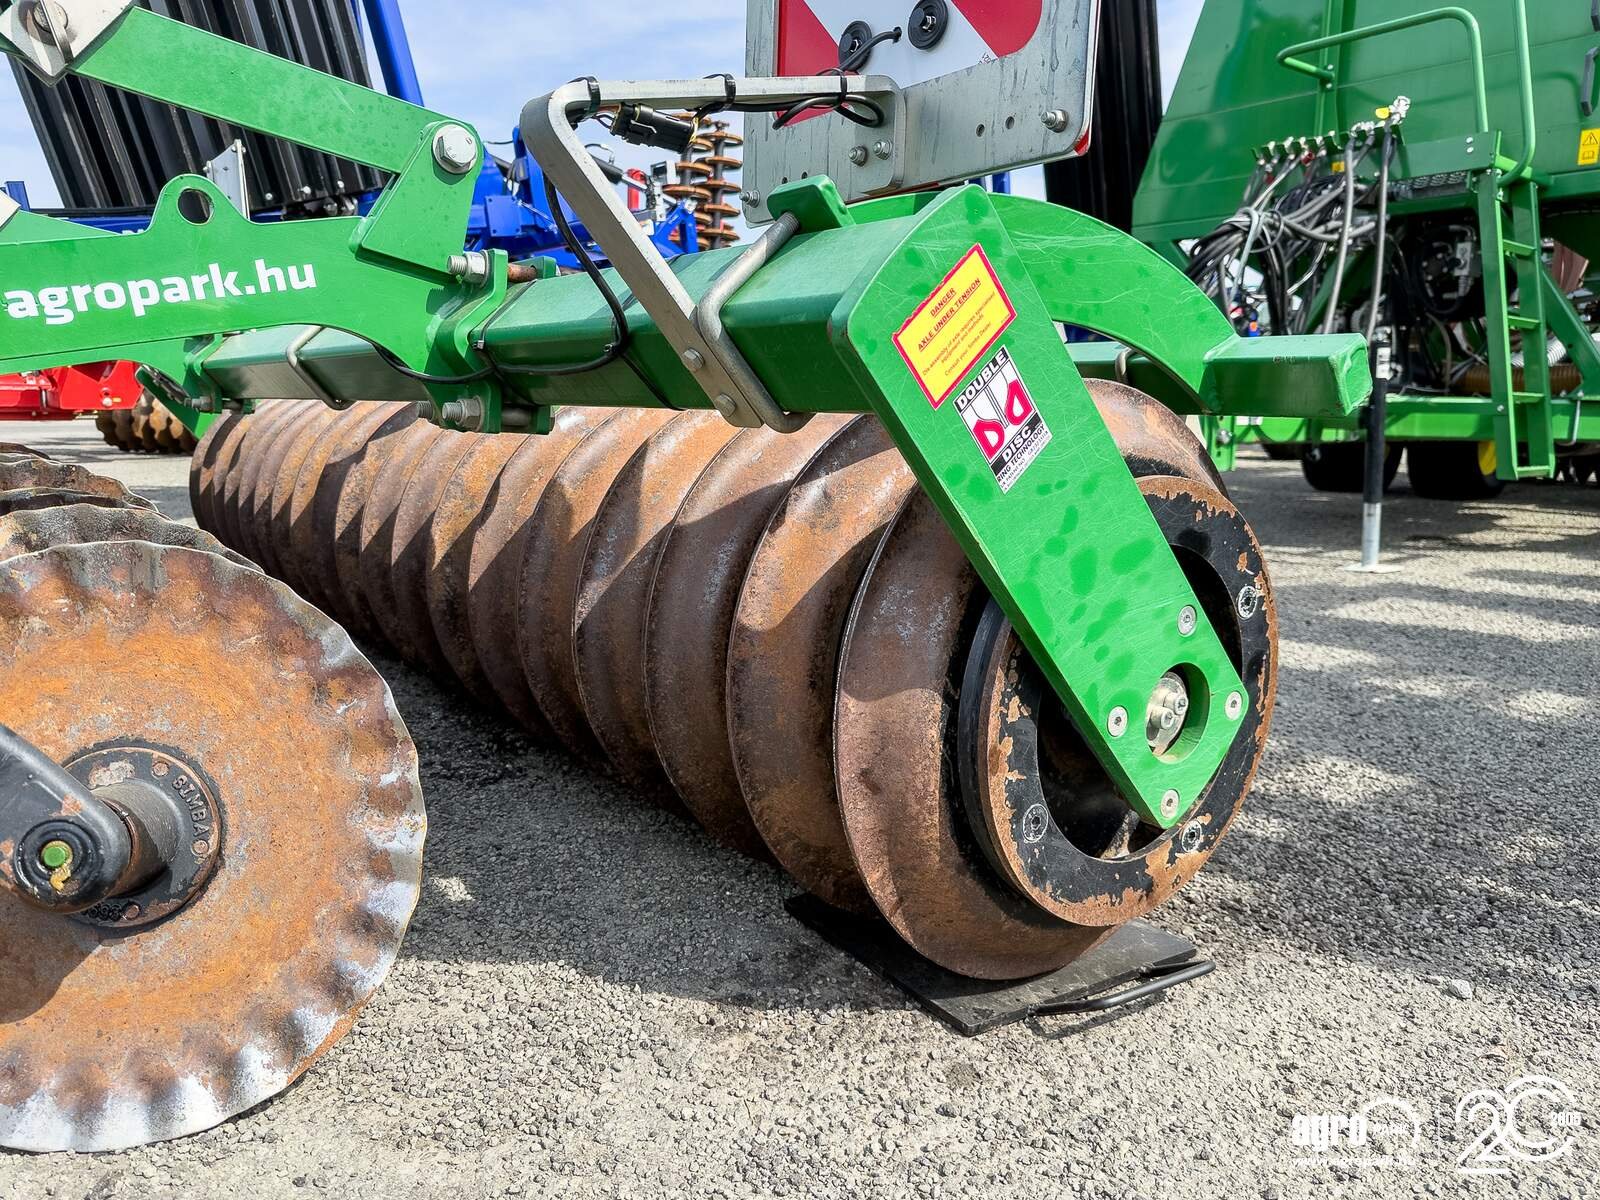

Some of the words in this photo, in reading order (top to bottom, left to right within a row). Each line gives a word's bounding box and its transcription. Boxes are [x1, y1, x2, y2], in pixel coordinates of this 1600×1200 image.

[4, 259, 317, 324] agropark.hu
[917, 330, 934, 351] AXLE
[934, 306, 955, 332] UNDER
[955, 277, 981, 308] TENSION
[930, 287, 956, 317] DANGER
[956, 351, 1008, 410] DOUBLE
[997, 464, 1012, 483] RING
[1011, 423, 1045, 467] TECHNOLOGY
[1002, 424, 1032, 463] DISC
[172, 775, 209, 837] SIMBA
